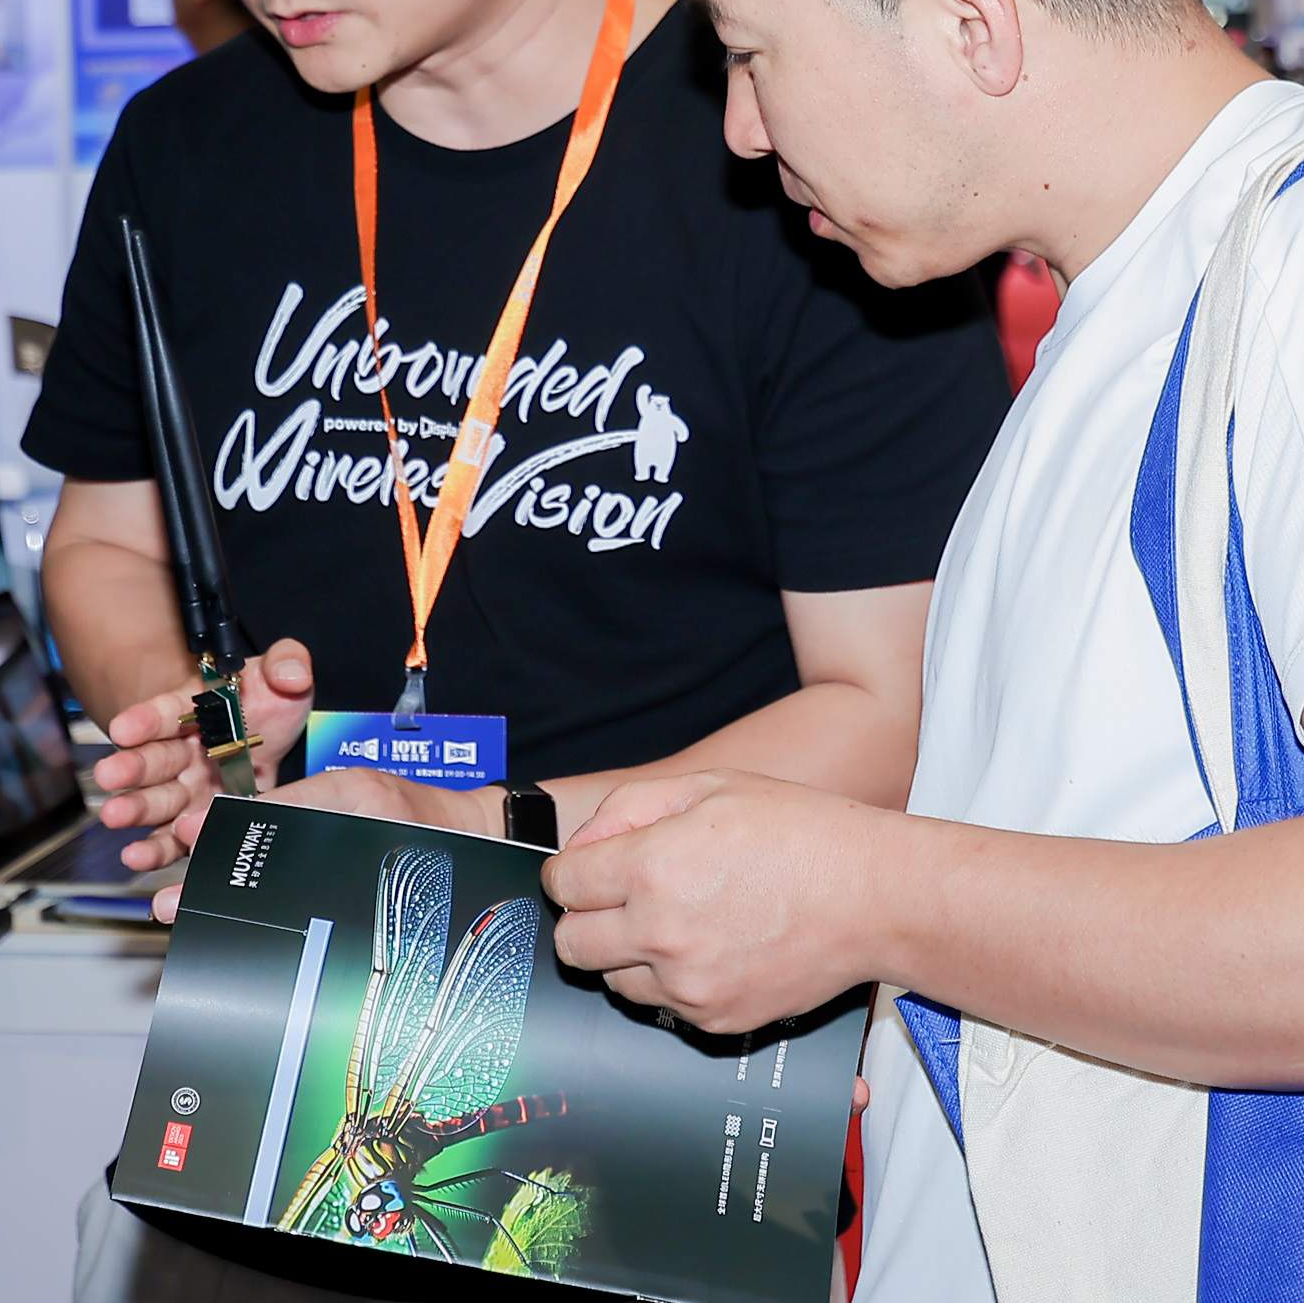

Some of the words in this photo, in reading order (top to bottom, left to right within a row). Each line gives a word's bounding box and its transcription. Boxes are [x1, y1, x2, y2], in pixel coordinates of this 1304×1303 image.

[397, 418, 418, 437] by
[391, 740, 430, 755] IOTE
[229, 821, 267, 887] MUXWAVE
